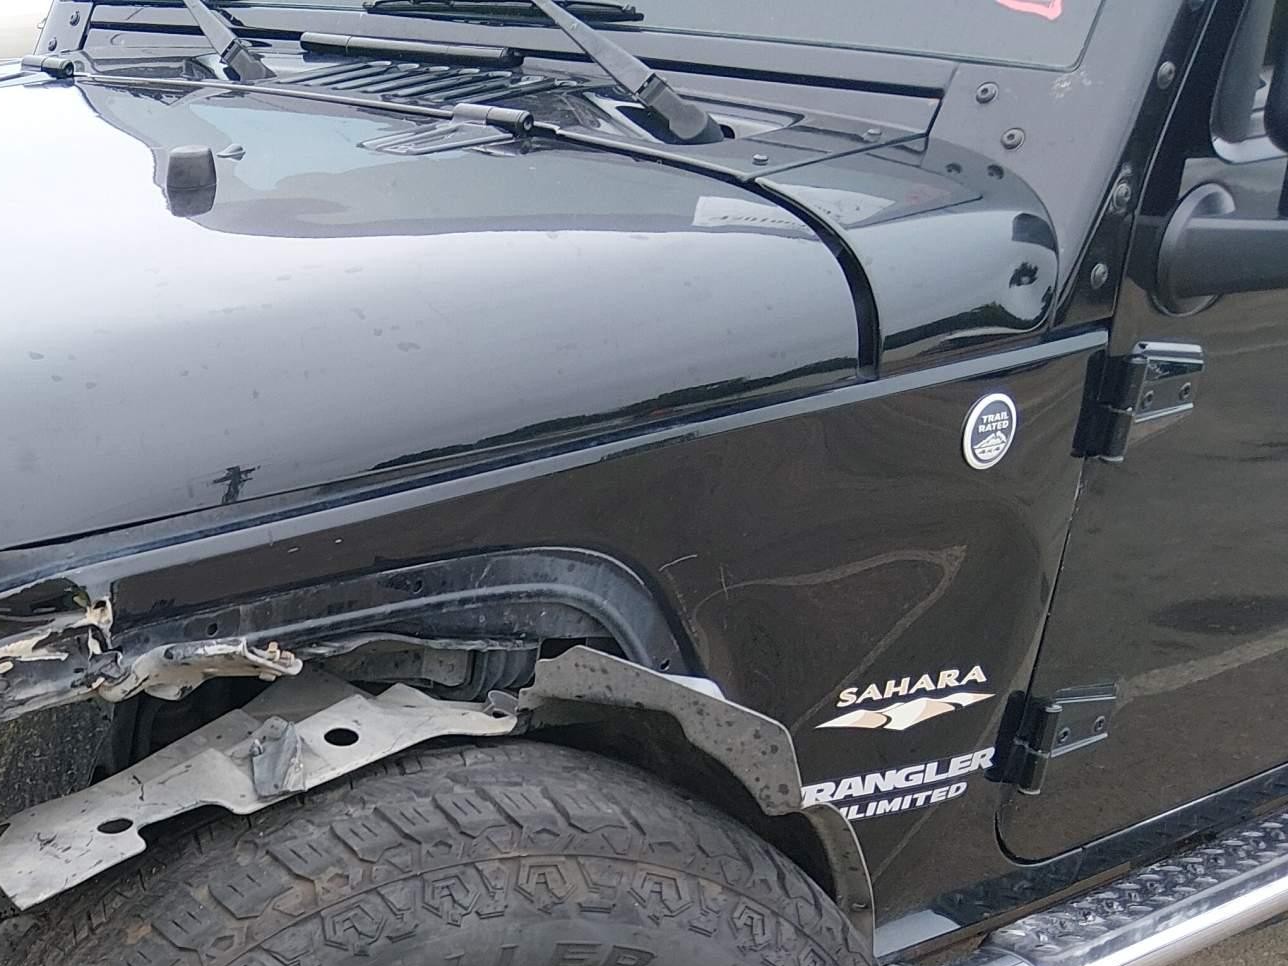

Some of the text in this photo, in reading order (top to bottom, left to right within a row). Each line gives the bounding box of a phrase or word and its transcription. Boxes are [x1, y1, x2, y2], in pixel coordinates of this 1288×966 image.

[978, 420, 1009, 433] RATED
[982, 411, 1009, 424] TRAIL
[836, 665, 987, 708] SAHARA
[801, 747, 996, 809] RANGLER
[839, 782, 968, 820] LIMITED
